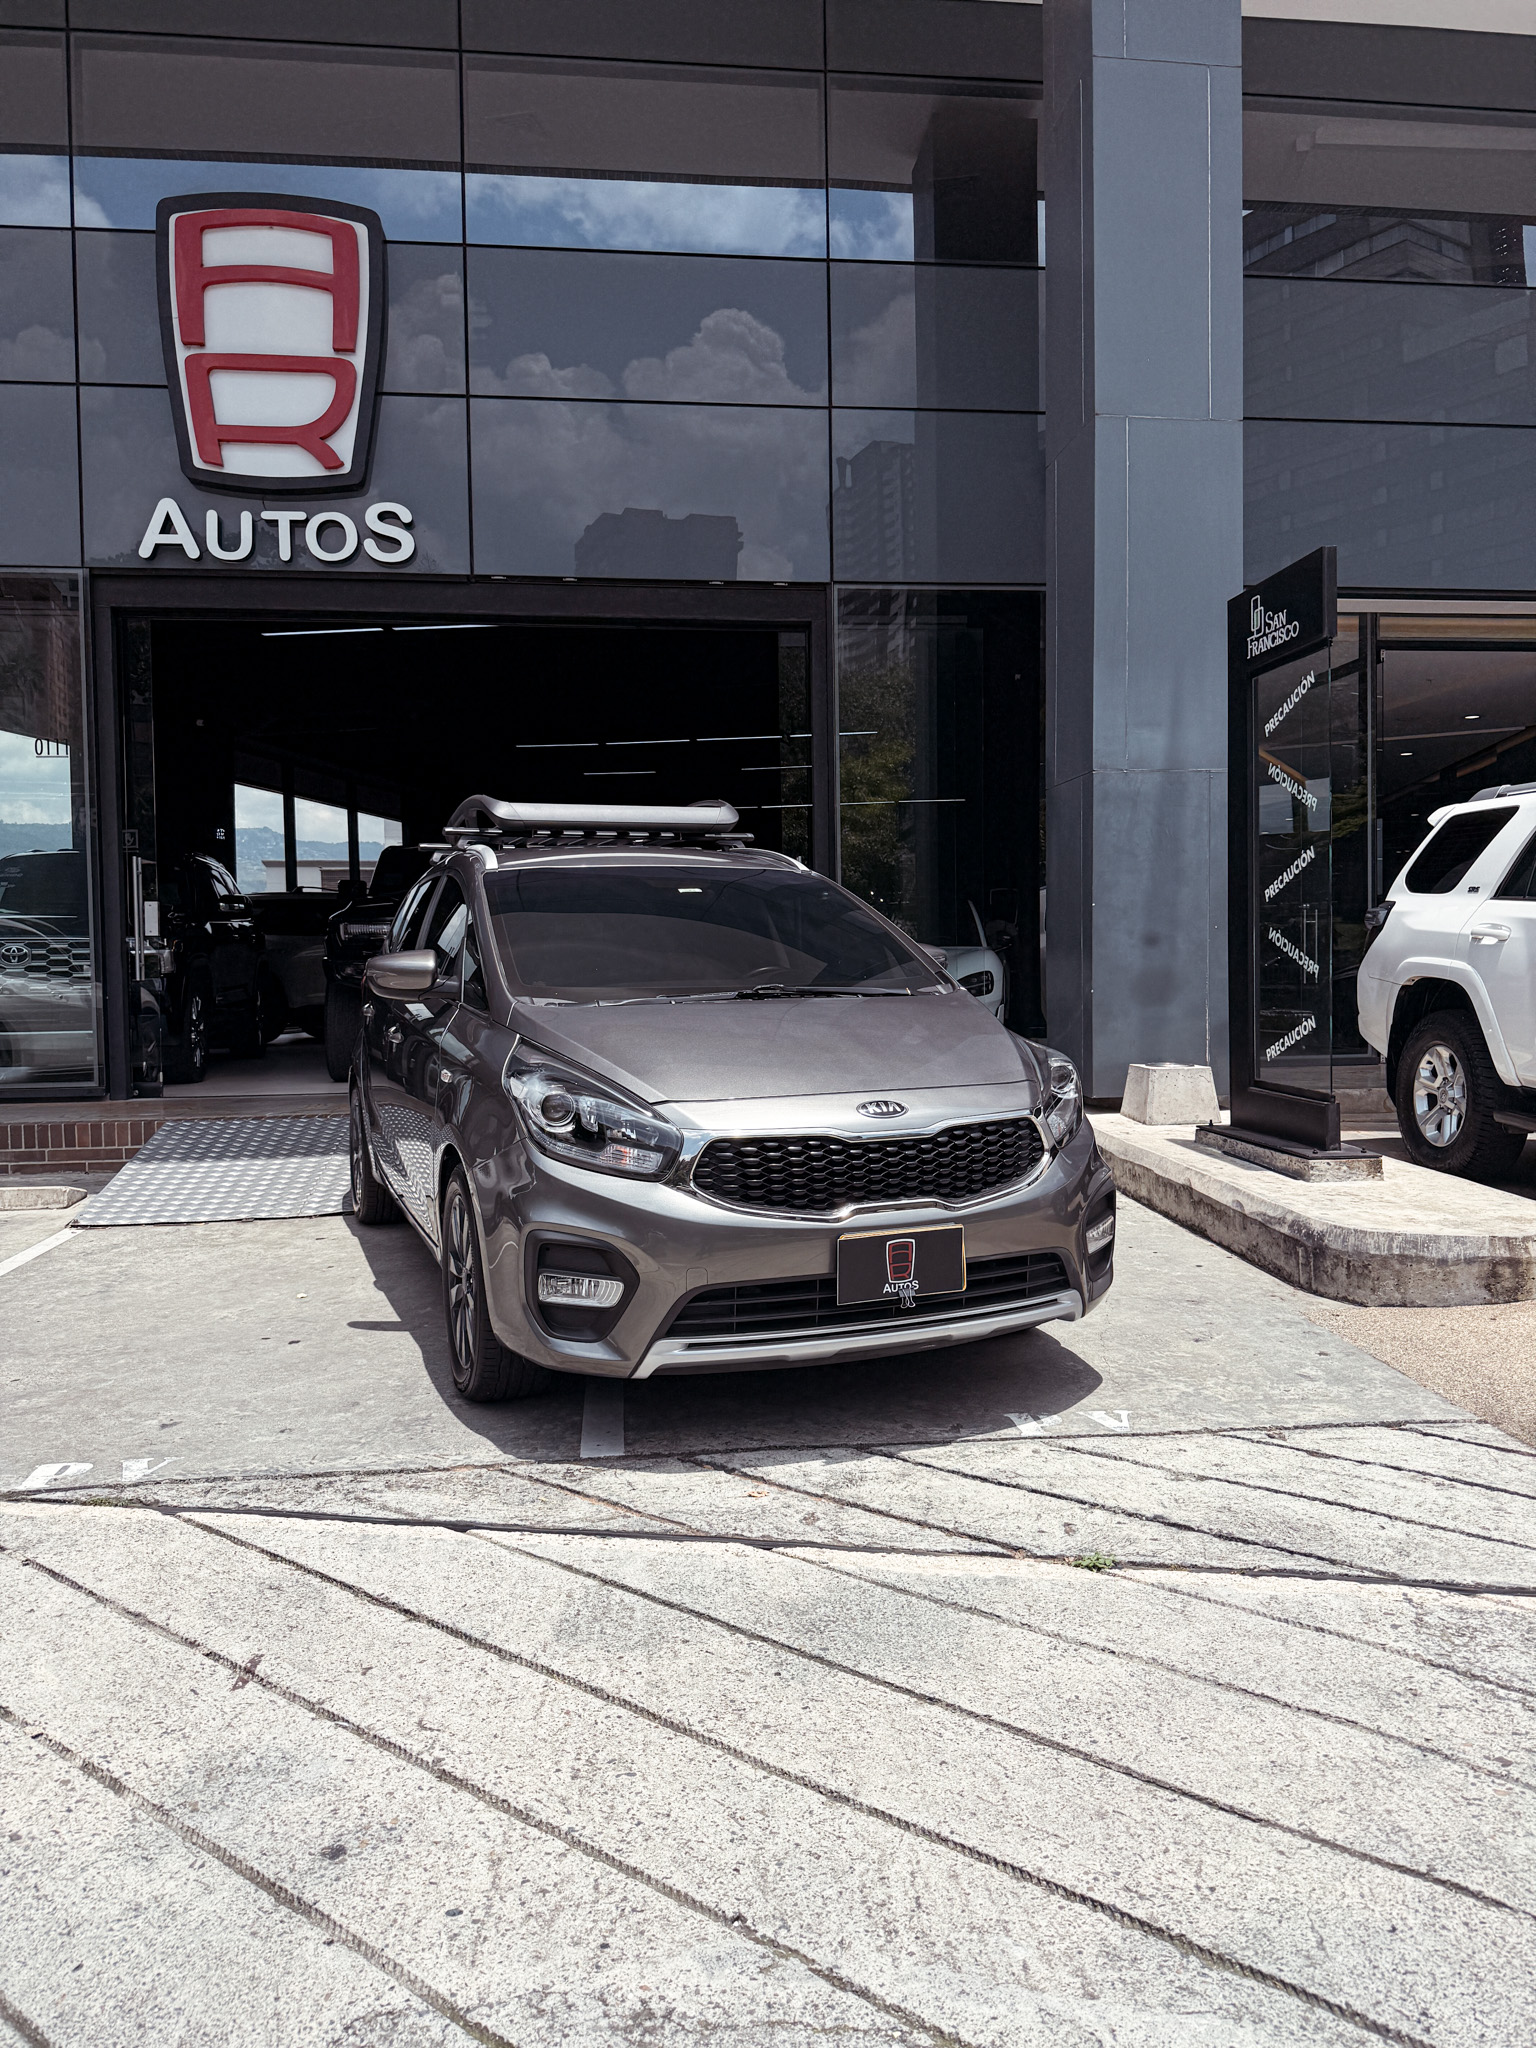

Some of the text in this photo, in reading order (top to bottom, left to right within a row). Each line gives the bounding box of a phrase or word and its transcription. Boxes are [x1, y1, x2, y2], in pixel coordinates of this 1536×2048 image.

[138, 497, 416, 563] AUTOS
[1246, 620, 1300, 660] FRANCISCO
[1265, 609, 1287, 634] SAN
[1264, 669, 1316, 738] PRECAUCIÓN
[1264, 845, 1316, 903] PRECAUCIÓN
[1265, 1015, 1317, 1062] PRECAUCIÓN
[865, 1101, 902, 1114] KIA
